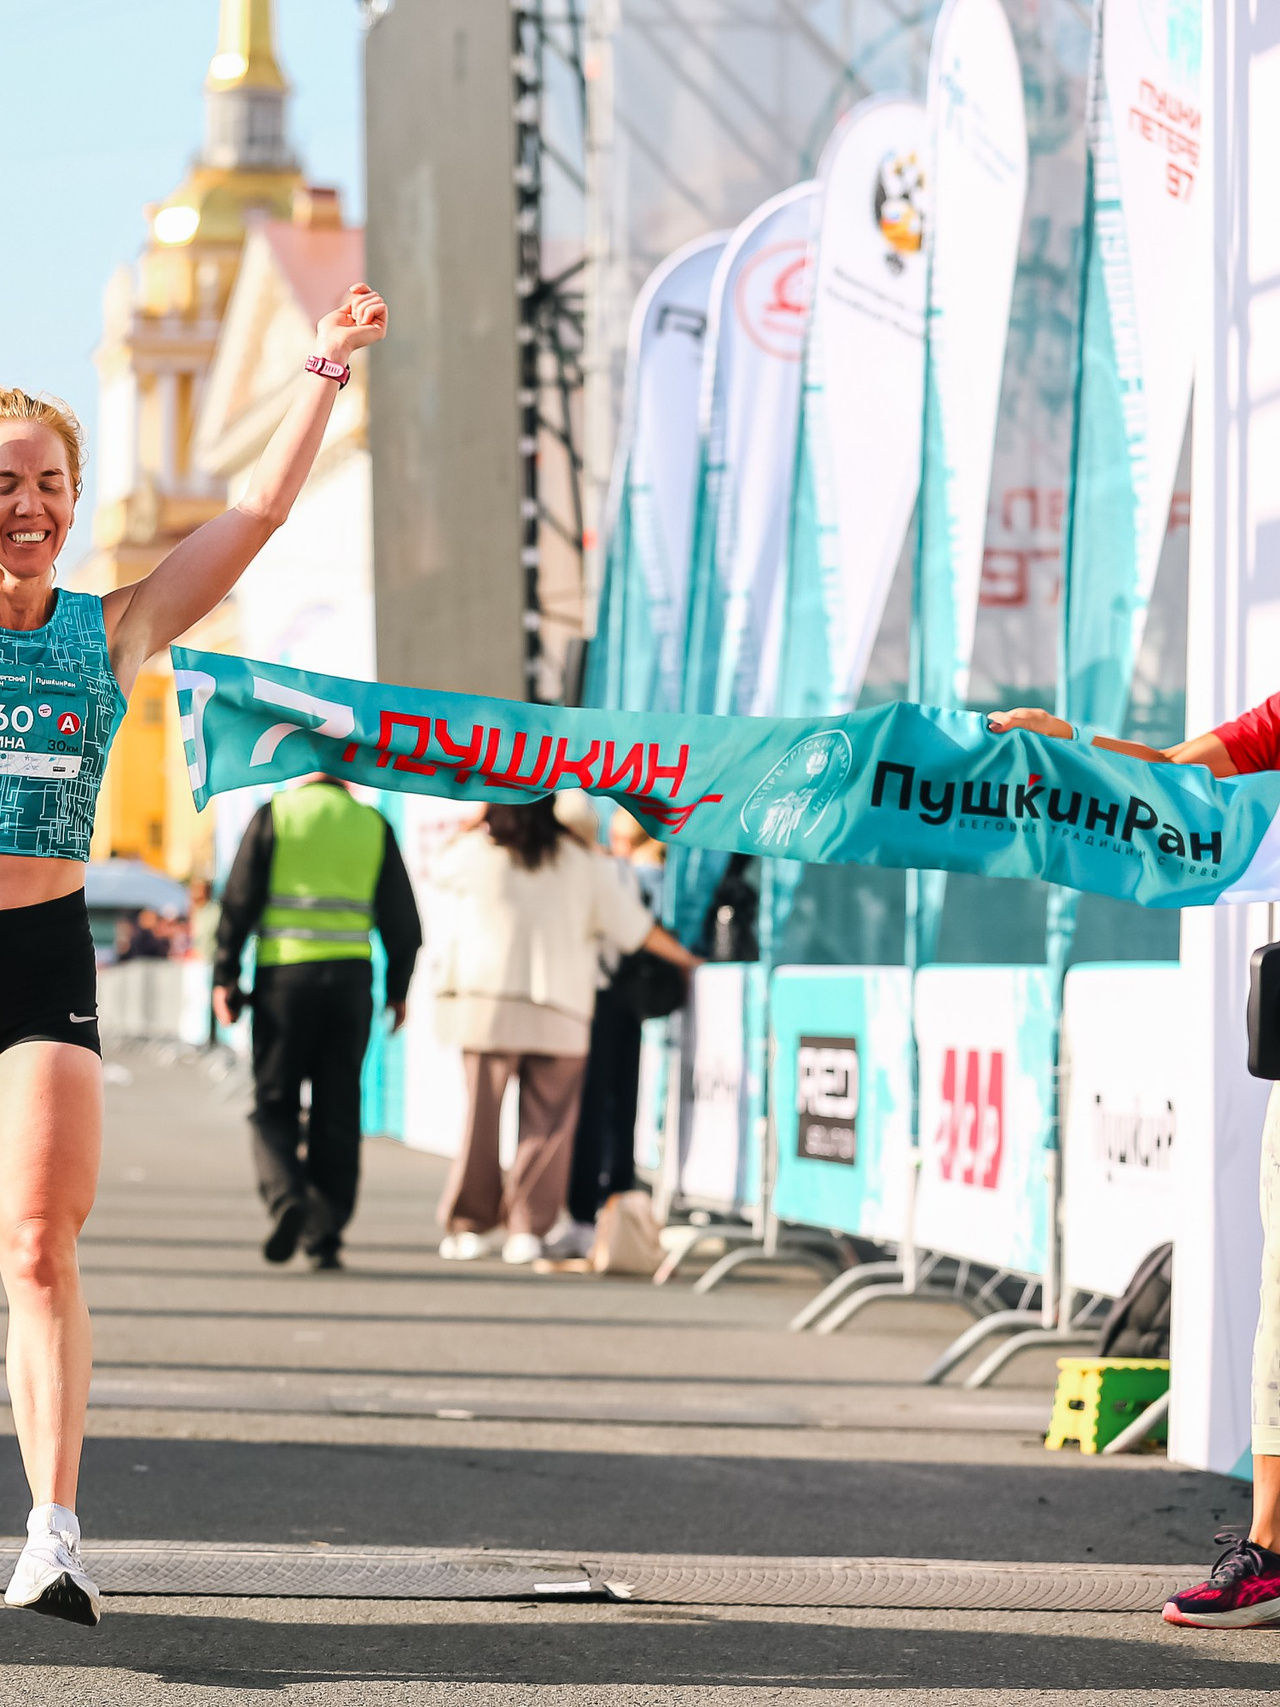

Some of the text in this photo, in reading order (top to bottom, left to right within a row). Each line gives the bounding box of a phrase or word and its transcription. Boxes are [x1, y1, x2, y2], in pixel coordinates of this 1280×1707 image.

[35, 677, 76, 689] ПушкинРан
[375, 709, 690, 798] ПУШКИН
[871, 760, 1223, 866] ПушкинРан
[1050, 824, 1147, 859] ТРАДИЦИИ
[1178, 862, 1220, 880] 1888
